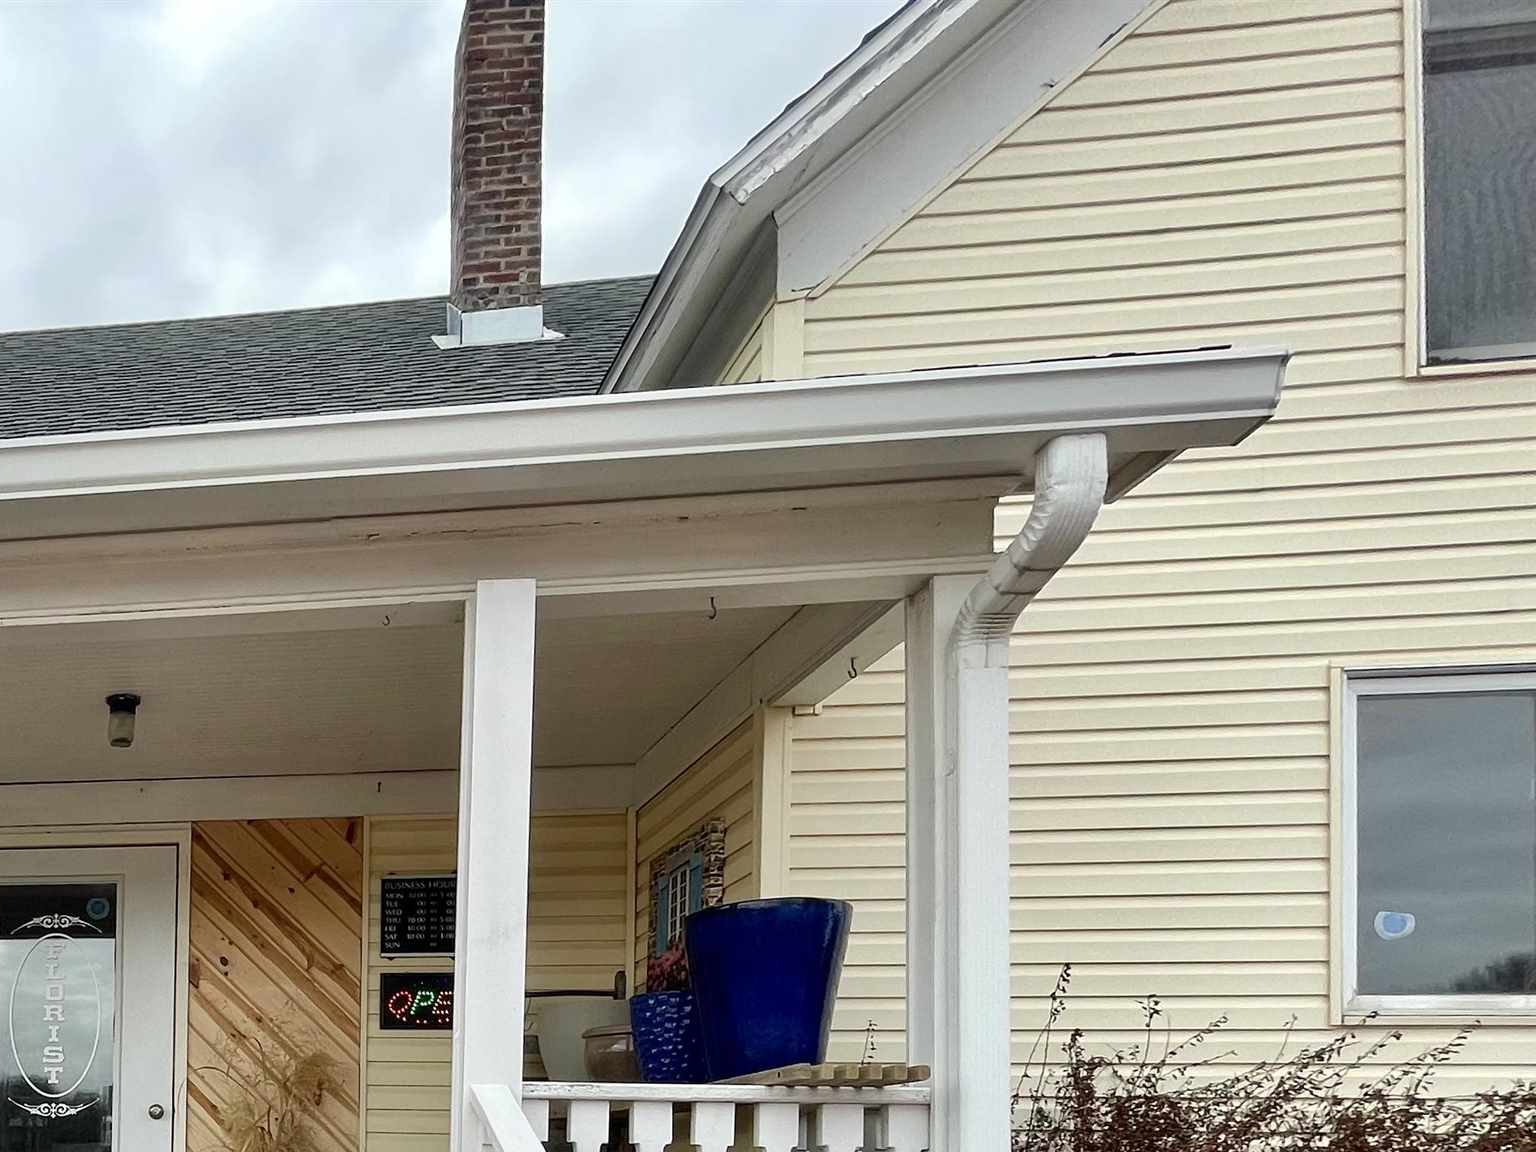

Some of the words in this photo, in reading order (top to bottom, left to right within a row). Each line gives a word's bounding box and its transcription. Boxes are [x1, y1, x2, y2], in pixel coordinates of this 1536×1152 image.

[384, 881, 426, 890] BUSINESS
[428, 880, 456, 889] HOUR
[42, 943, 66, 1084] FLORIST
[388, 990, 454, 1014] OPE
